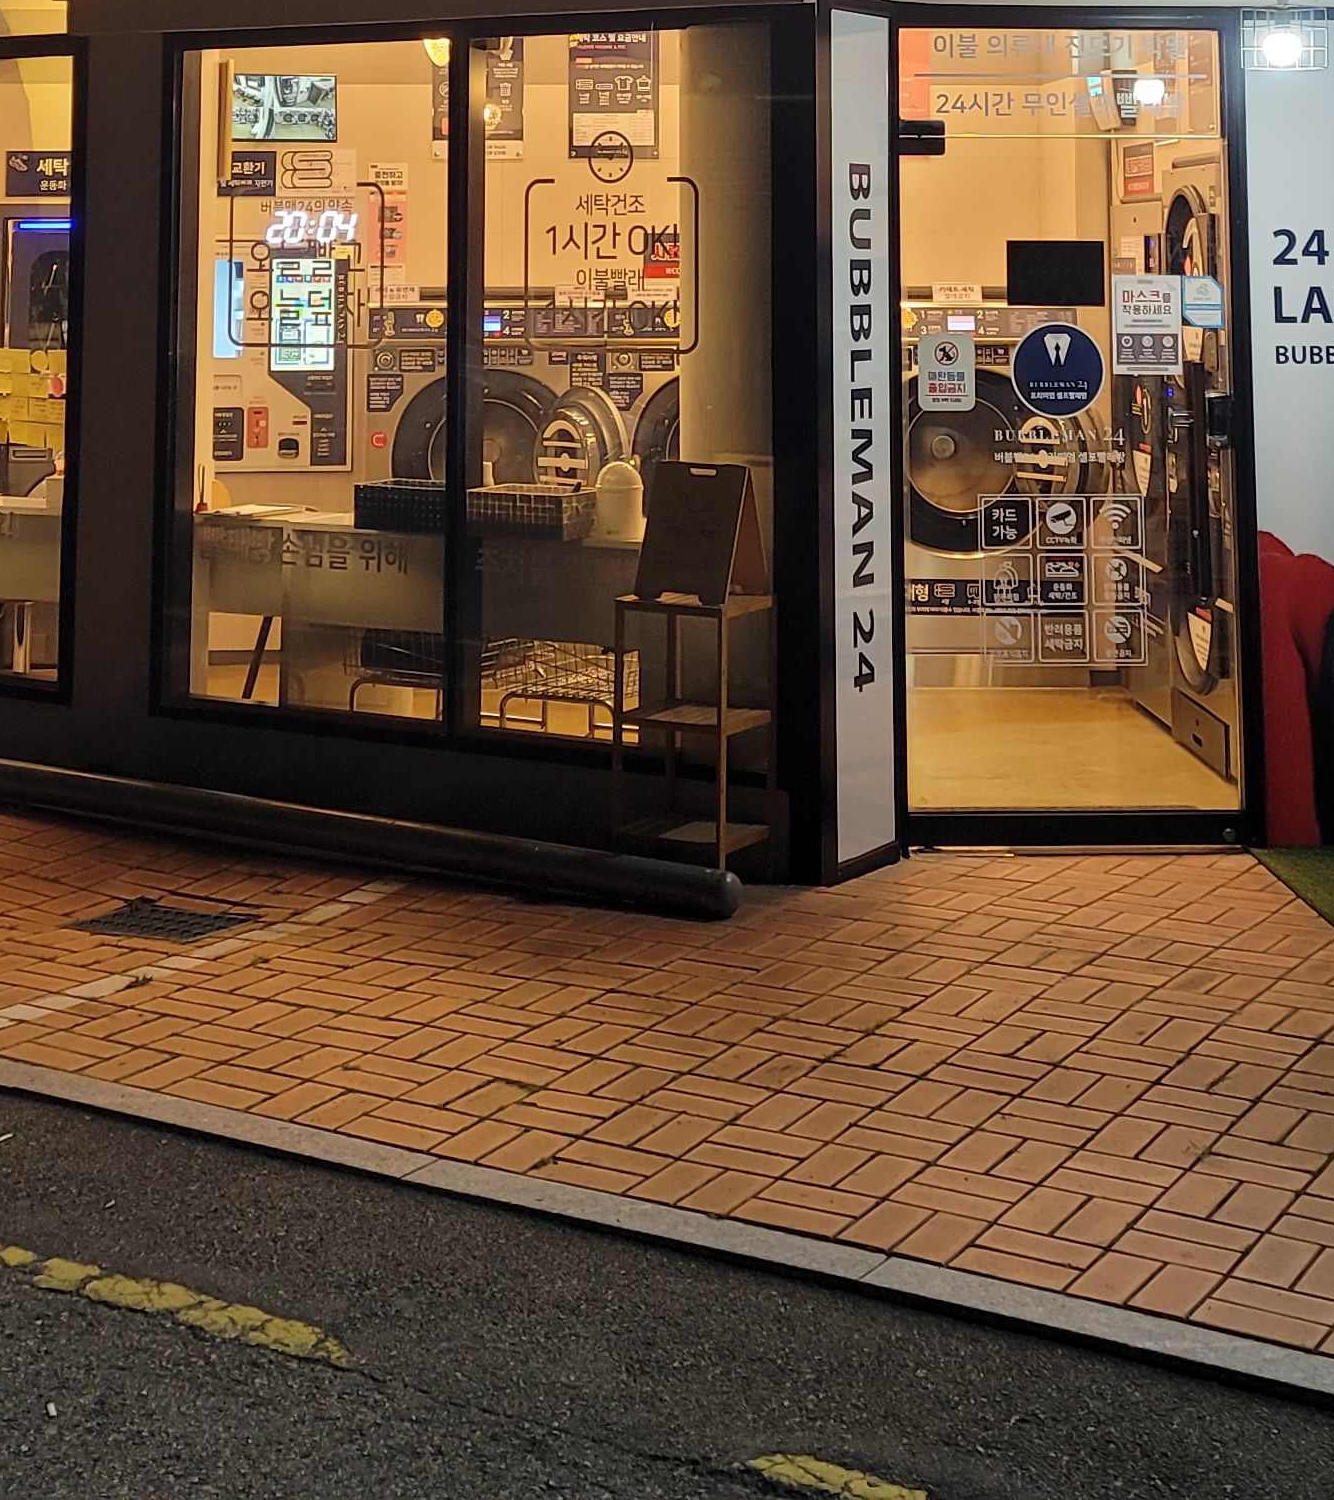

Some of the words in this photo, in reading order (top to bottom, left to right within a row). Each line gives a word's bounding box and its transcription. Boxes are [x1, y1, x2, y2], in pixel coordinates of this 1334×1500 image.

[933, 33, 979, 59] 이불
[935, 91, 1015, 117] 24시간
[35, 158, 69, 177] 세탁
[575, 192, 646, 217] 세탁건조
[265, 210, 359, 245] 20:04
[544, 222, 622, 260] 1시간
[627, 222, 679, 258] OK!
[1272, 228, 1330, 266] 24
[575, 267, 646, 292] 이불빨래
[1121, 289, 1172, 304] 마스크를
[1121, 304, 1173, 316] 착용하세요
[848, 162, 875, 589] BUBBLEMAN
[928, 382, 967, 394] 출입금지
[1102, 426, 1126, 446] 24
[991, 507, 1018, 523] 카드
[991, 525, 1019, 541] 가능
[280, 533, 351, 571] 손님을
[358, 536, 408, 575] 위해
[851, 607, 877, 693] 24
